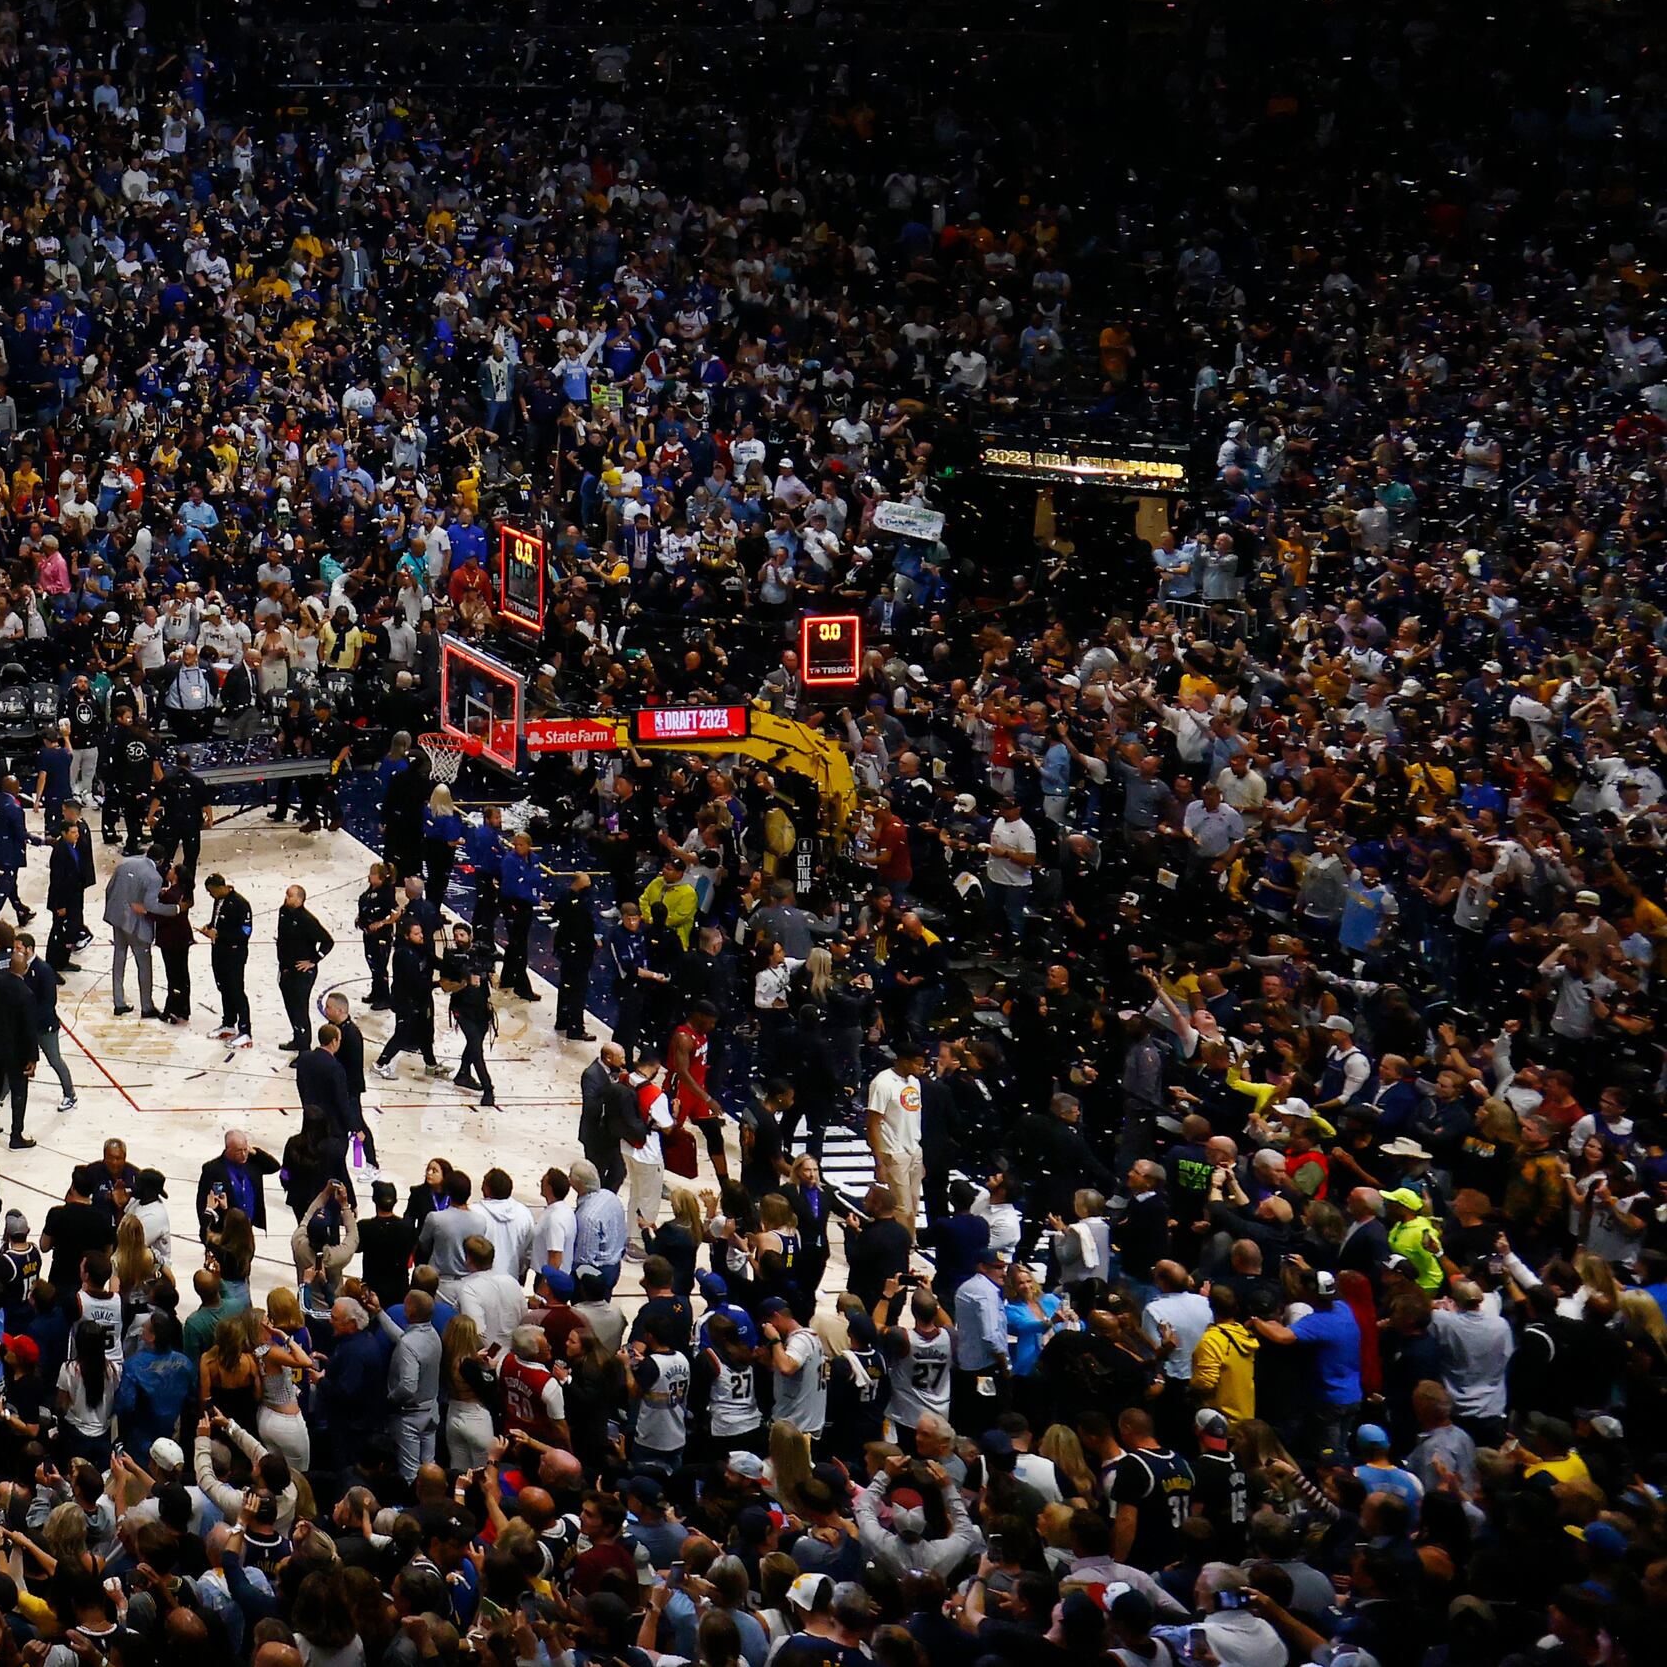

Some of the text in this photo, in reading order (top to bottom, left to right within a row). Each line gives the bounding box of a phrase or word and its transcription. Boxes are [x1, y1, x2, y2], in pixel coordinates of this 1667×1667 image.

[984, 447, 1031, 465] 2023
[1076, 456, 1184, 480] CHAMPIONS
[821, 665, 856, 676] TISSOT
[664, 708, 728, 731] DRAFT 2023
[544, 728, 609, 746] StateFarm
[797, 854, 812, 867] GET
[796, 867, 812, 880] THE
[796, 881, 812, 894] APP
[89, 1310, 114, 1323] JOKIC
[912, 1362, 948, 1394] 27
[731, 1373, 751, 1399] 27
